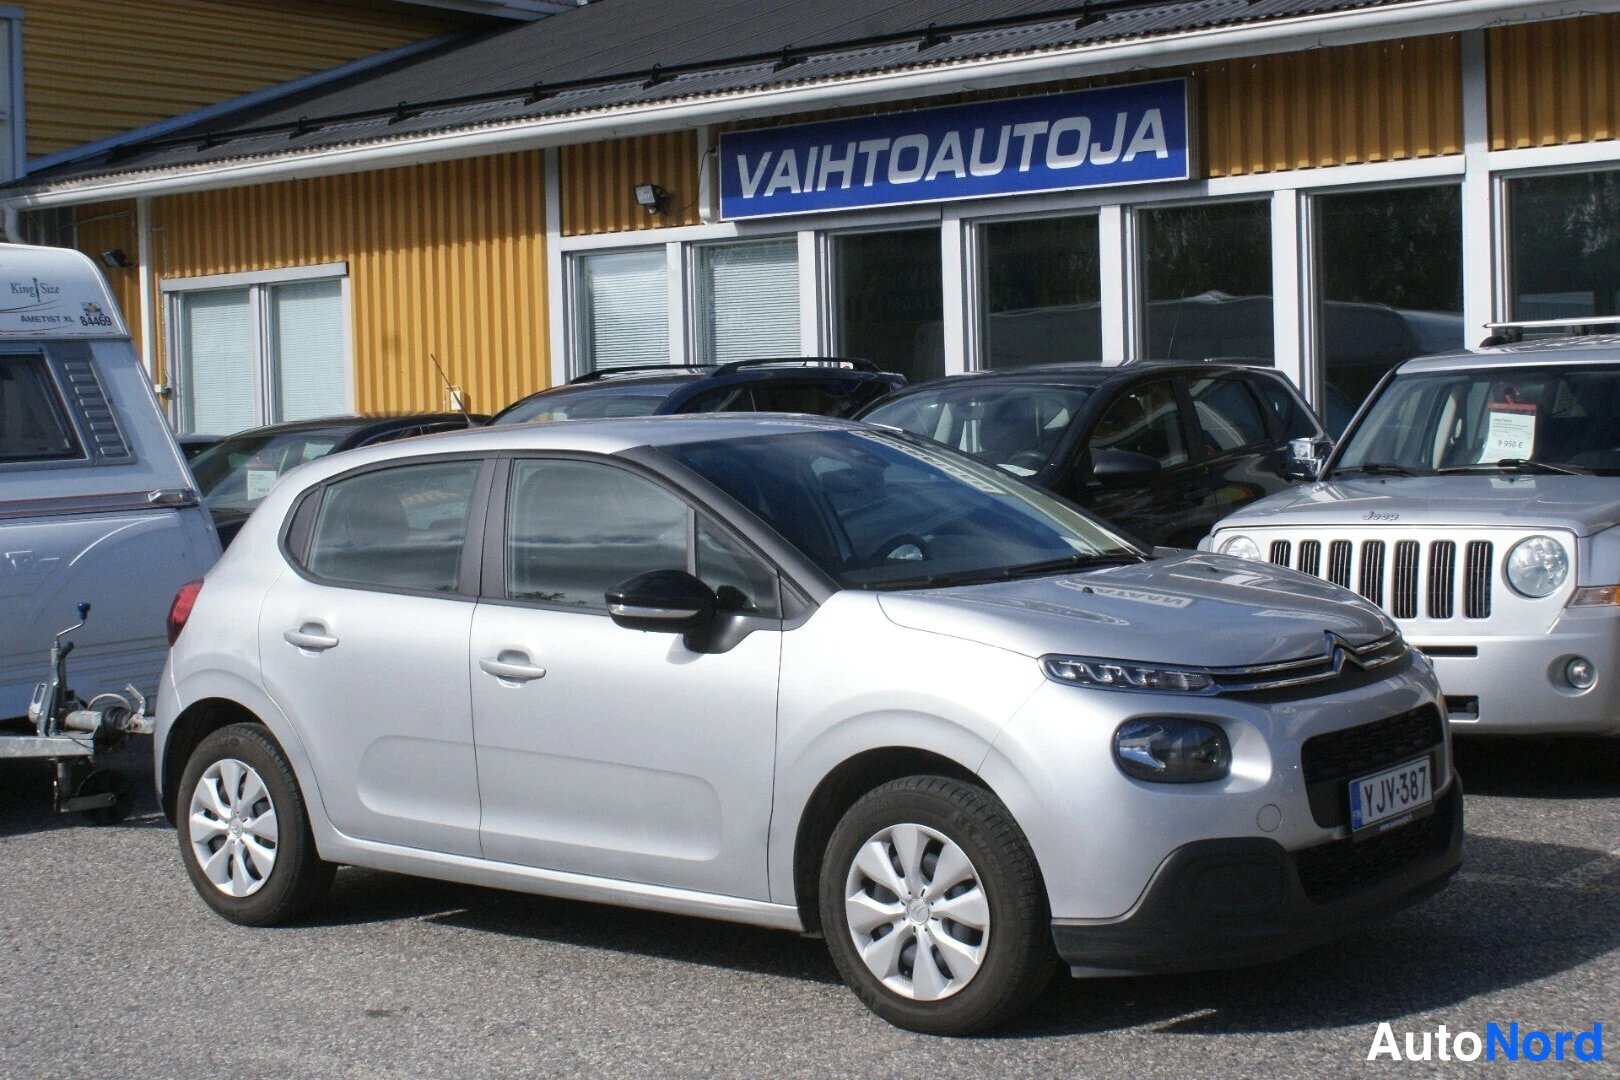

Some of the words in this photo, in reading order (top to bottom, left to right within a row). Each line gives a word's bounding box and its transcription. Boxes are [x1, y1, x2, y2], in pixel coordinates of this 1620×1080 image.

[736, 108, 1169, 199] VAIHTOAUTOJA
[10, 282, 36, 298] King
[40, 282, 60, 294] Size
[20, 315, 61, 323] AMETIST
[63, 315, 76, 323] XL
[79, 314, 113, 327] 84469
[1361, 510, 1400, 522] Jeep
[1363, 765, 1427, 818] YJV-387
